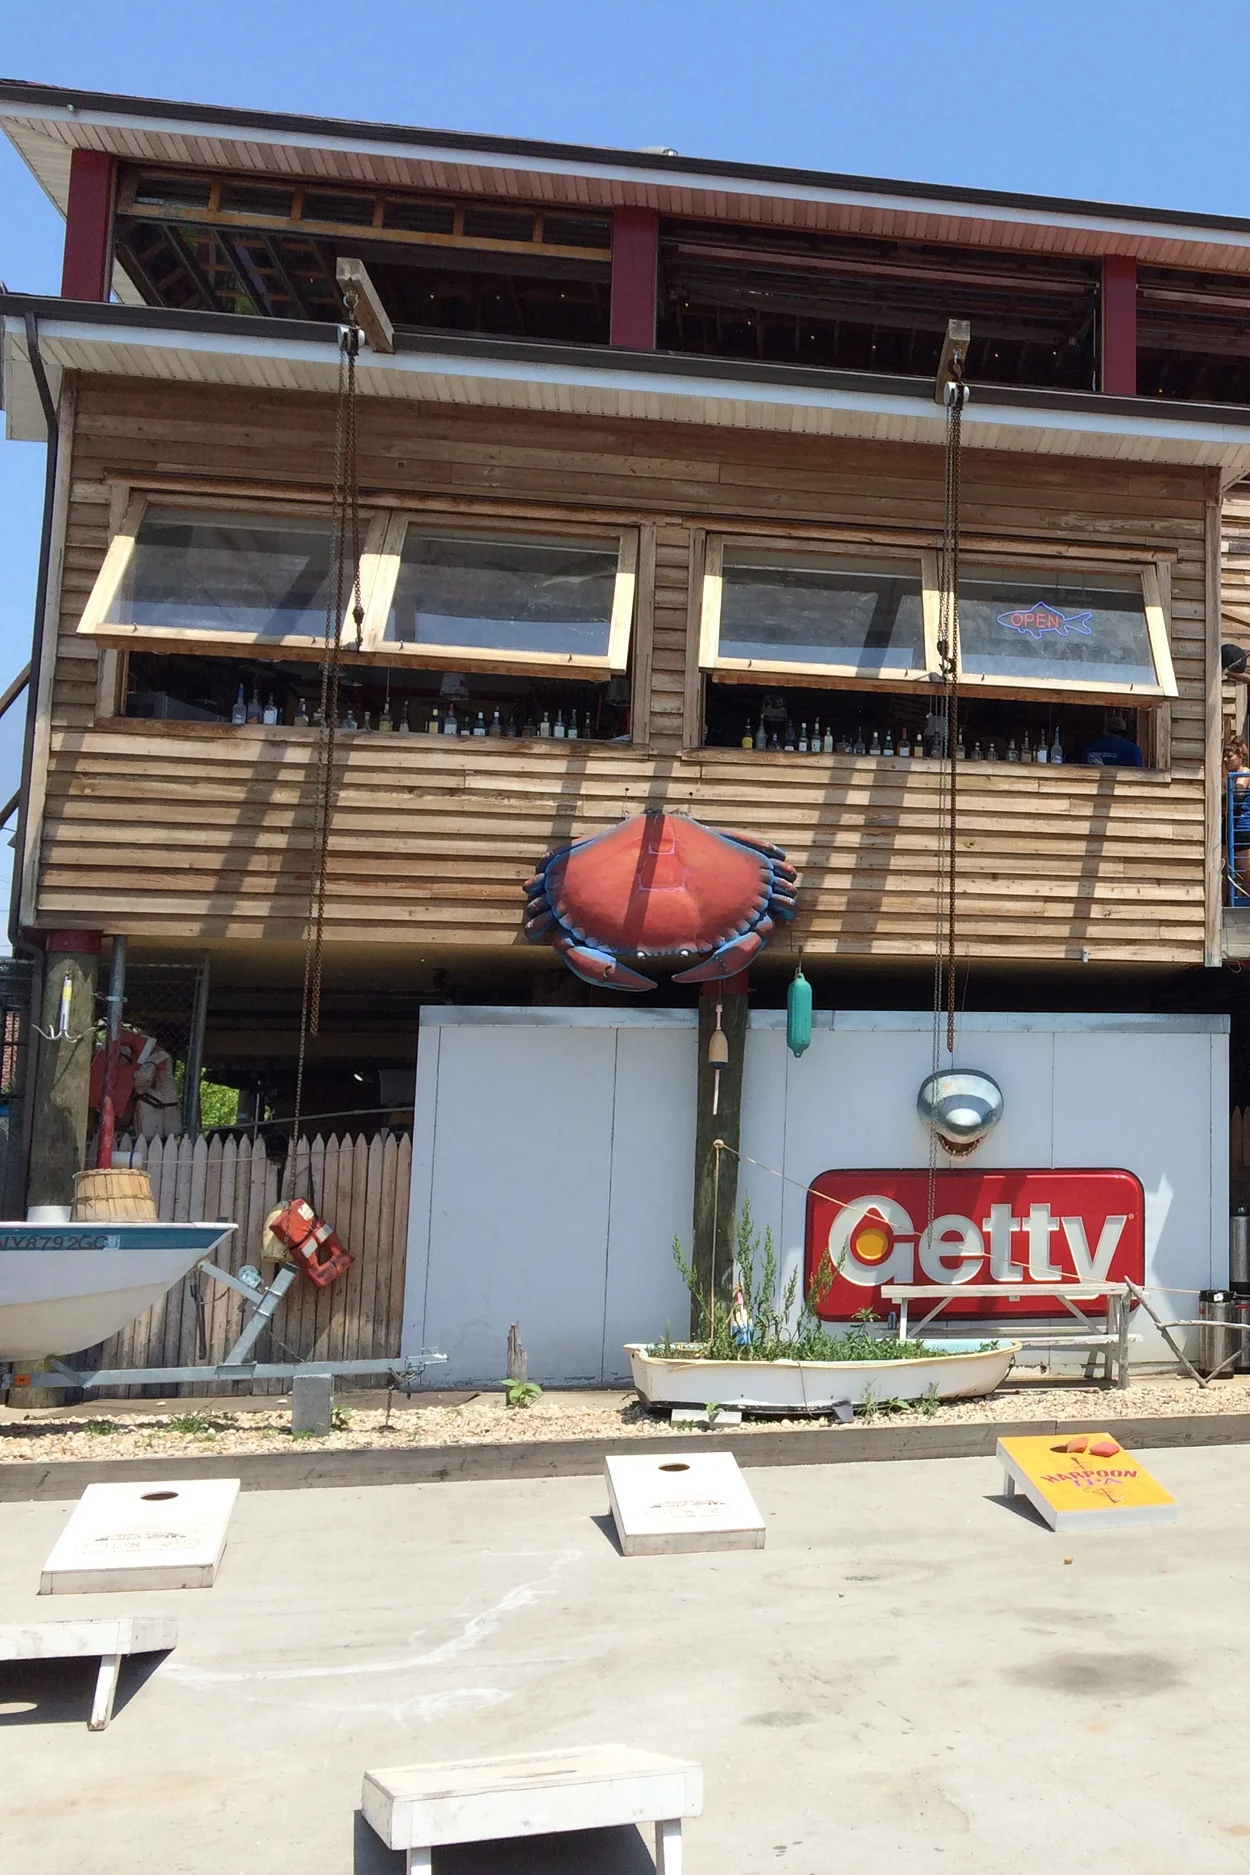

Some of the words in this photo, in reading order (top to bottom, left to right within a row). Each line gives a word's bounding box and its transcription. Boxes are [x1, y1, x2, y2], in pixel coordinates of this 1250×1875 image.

[1010, 613, 1059, 628] OPEN
[828, 1194, 1128, 1301] Getty
[1040, 1470, 1137, 1483] HARPOON
